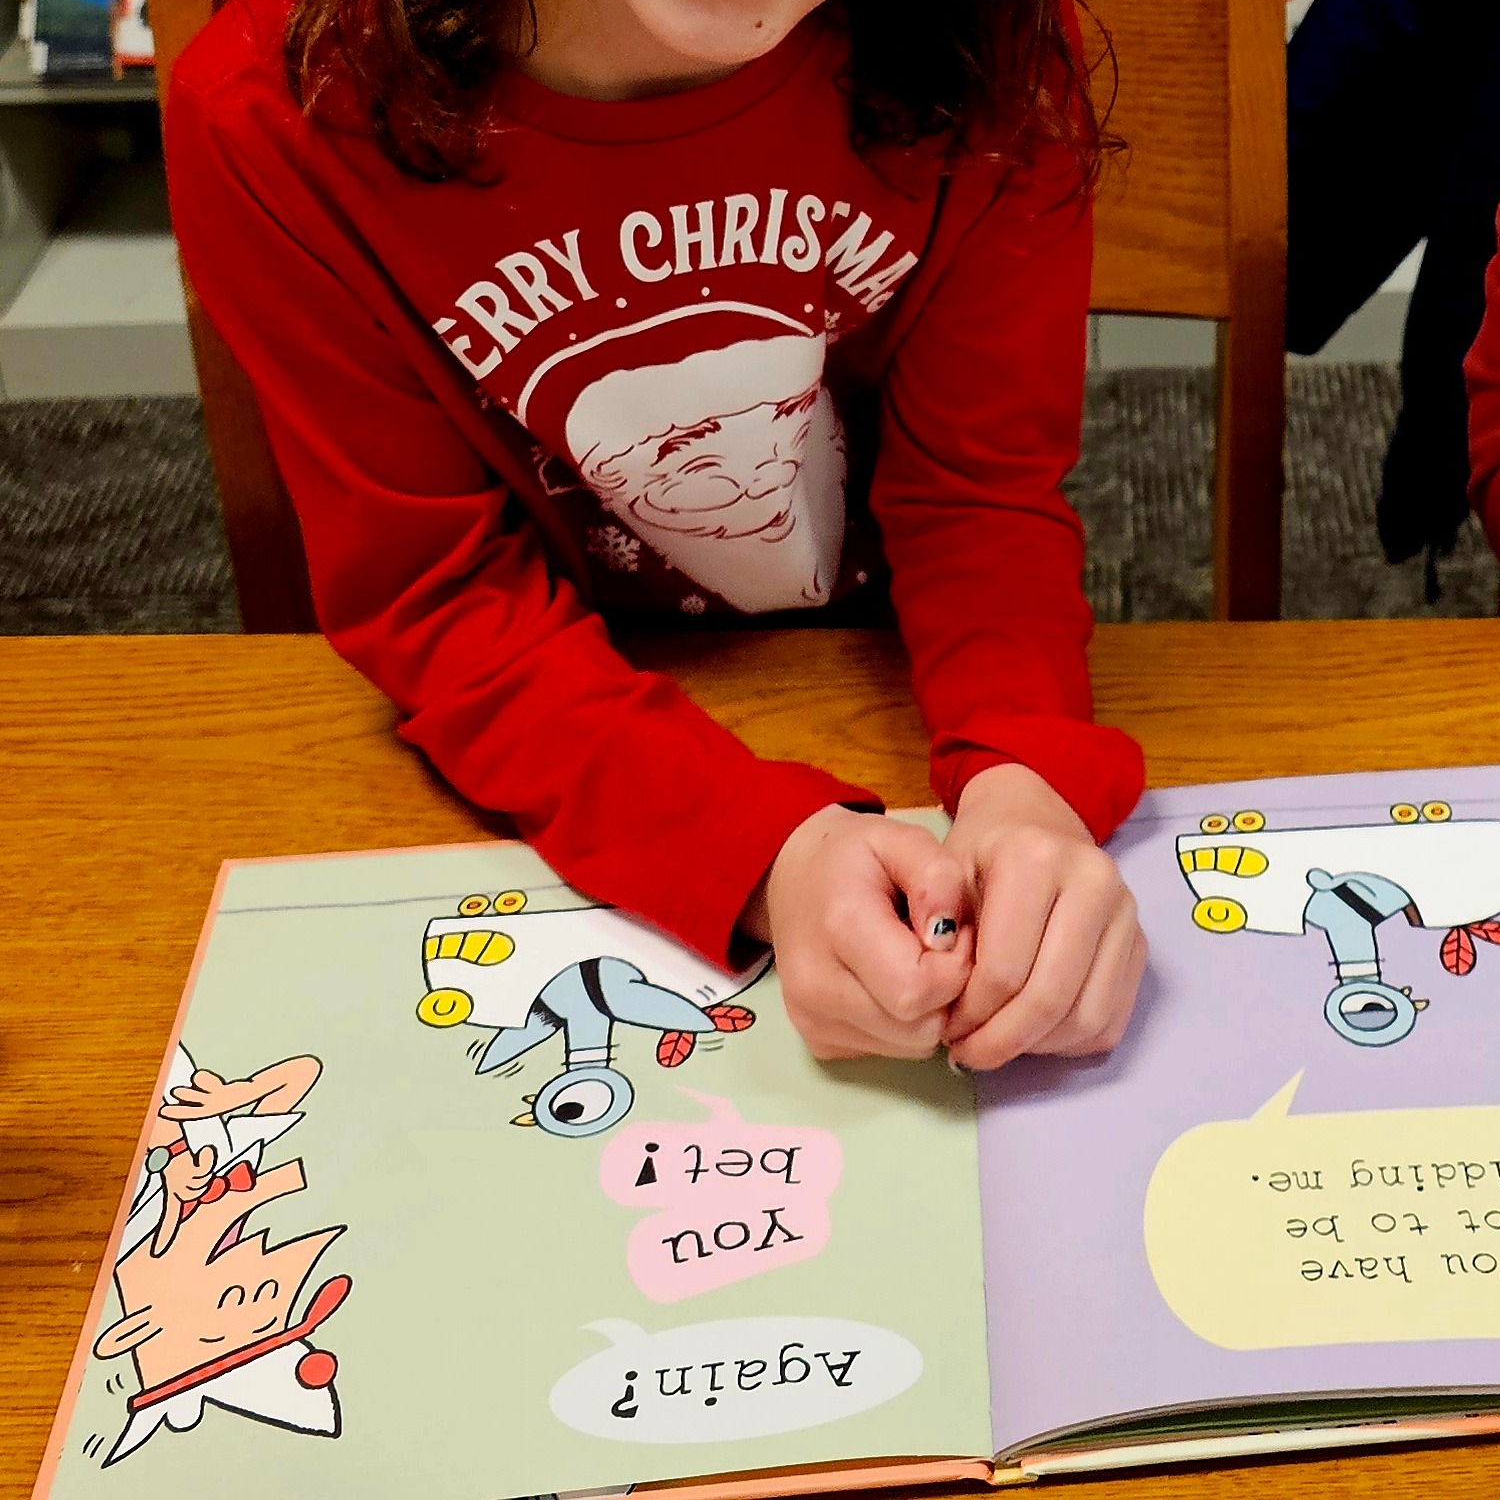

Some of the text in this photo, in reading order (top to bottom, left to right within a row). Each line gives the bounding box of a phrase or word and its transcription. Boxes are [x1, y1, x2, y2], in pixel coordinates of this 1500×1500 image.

[431, 228, 599, 381] ERRY
[634, 1141, 803, 1187] bet!
[1251, 1166, 1324, 1193] me.
[662, 1206, 804, 1264] You
[1286, 1213, 1345, 1243] be
[1371, 1211, 1429, 1236] to
[1300, 1251, 1413, 1283] have
[610, 1342, 862, 1419] Again?
